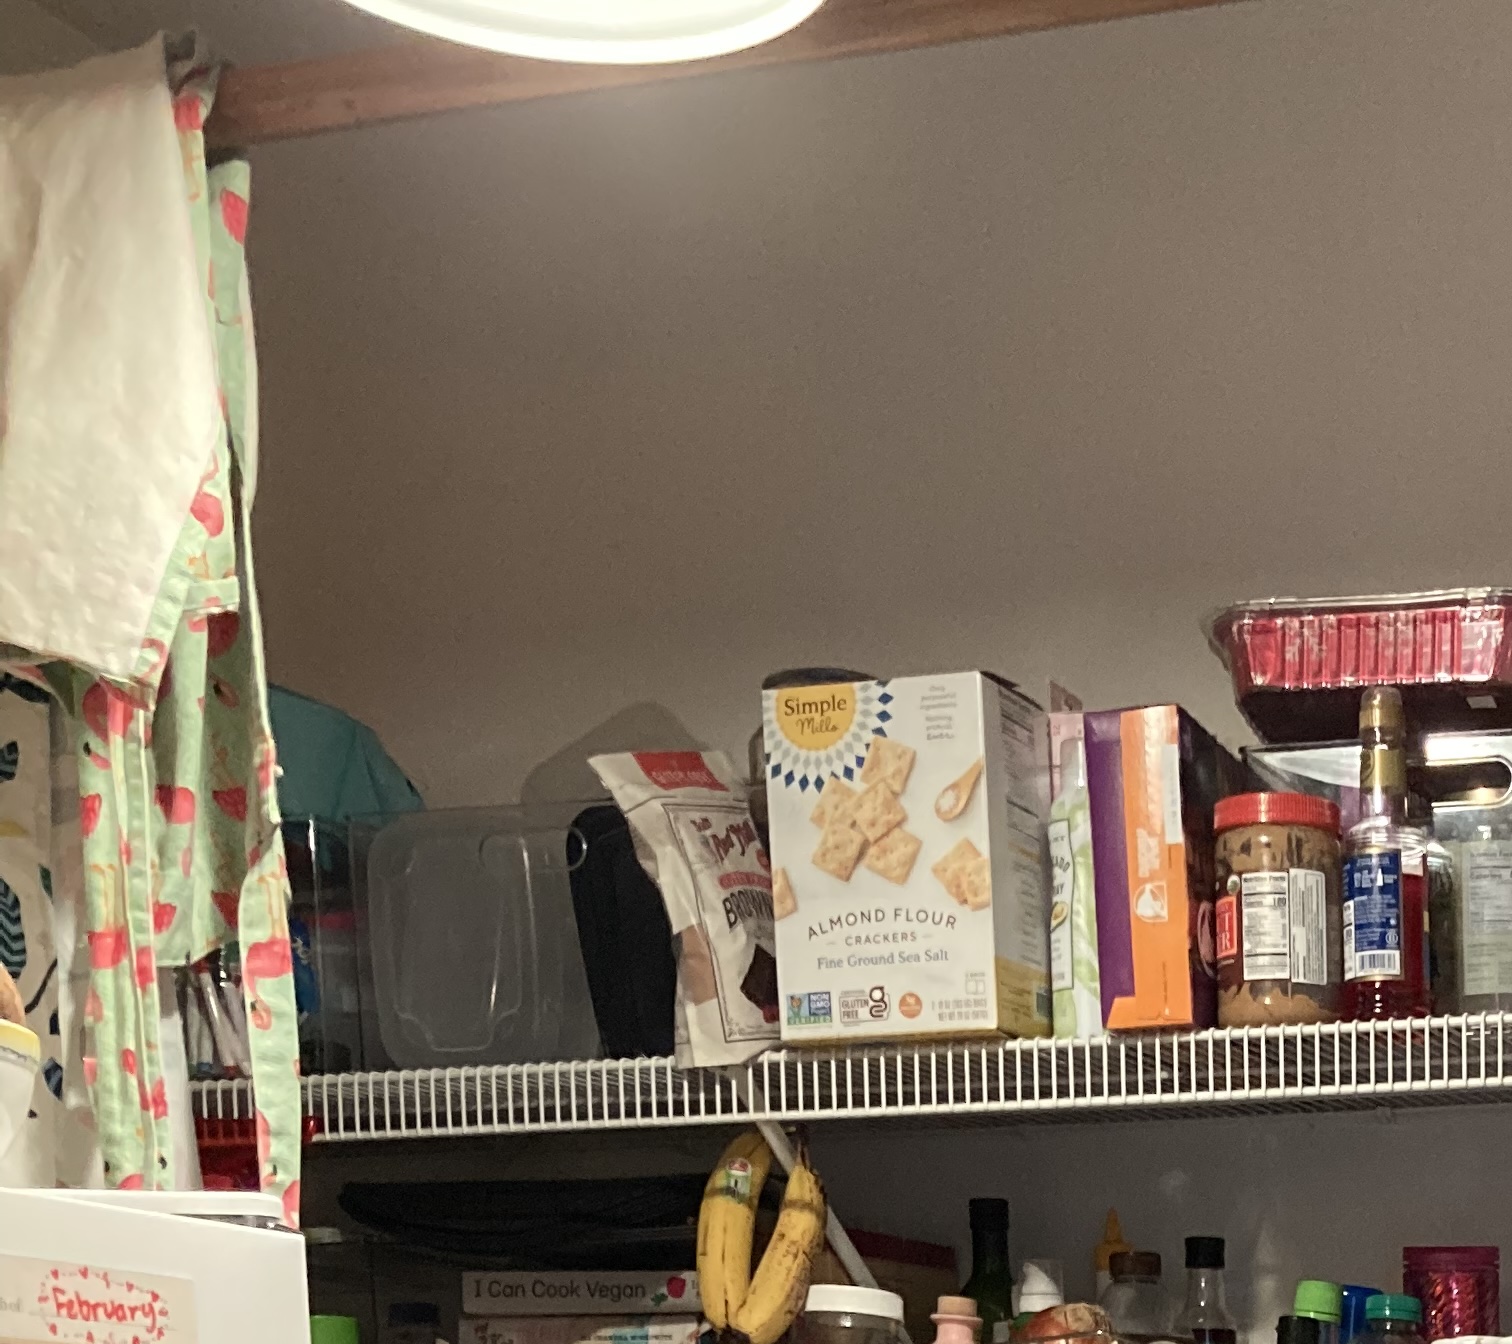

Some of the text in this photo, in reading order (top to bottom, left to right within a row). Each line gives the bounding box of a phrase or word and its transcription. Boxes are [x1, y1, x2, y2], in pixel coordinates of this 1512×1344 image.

[784, 694, 847, 717] Simple
[796, 716, 838, 735] Mills
[807, 907, 957, 941] ALMOND FLOUR
[844, 931, 918, 947] CRACKERS
[816, 949, 949, 970] Fine Ground Sea Salt
[810, 993, 830, 1001] NON
[841, 999, 869, 1009] GLUTEN
[842, 1010, 859, 1020] FREE
[474, 1279, 646, 1302] I Can Cook Vegan
[51, 1286, 157, 1333] February
